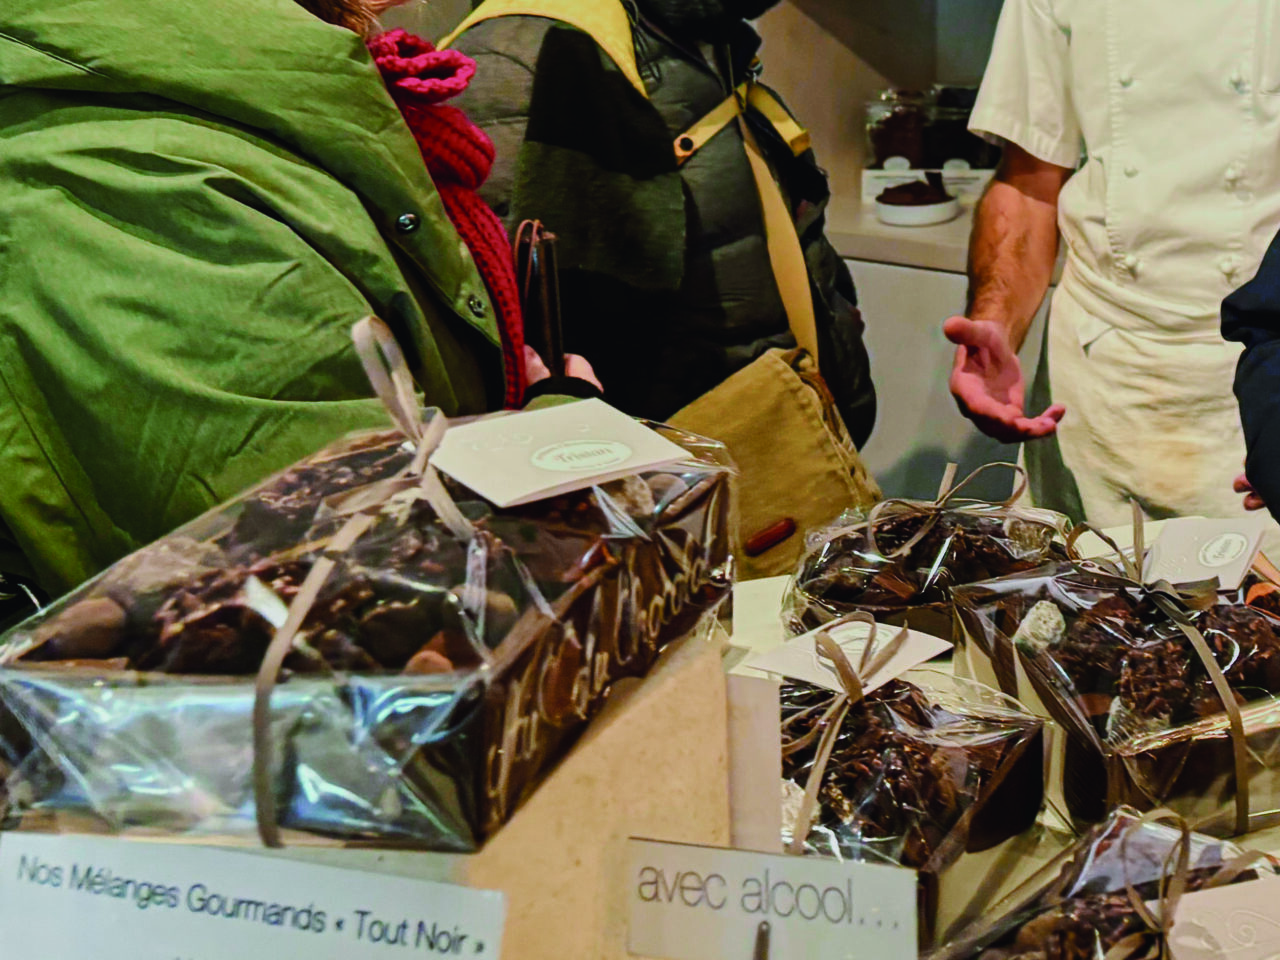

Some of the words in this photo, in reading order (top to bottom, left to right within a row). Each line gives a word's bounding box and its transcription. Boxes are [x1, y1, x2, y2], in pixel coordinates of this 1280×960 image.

[17, 854, 63, 888] Nos
[68, 863, 181, 909] Mélanges
[186, 883, 327, 933] Gourmands
[353, 909, 409, 945] Tout
[415, 919, 468, 954] Noir
[637, 865, 727, 910] avec
[740, 867, 899, 929] alcool...
